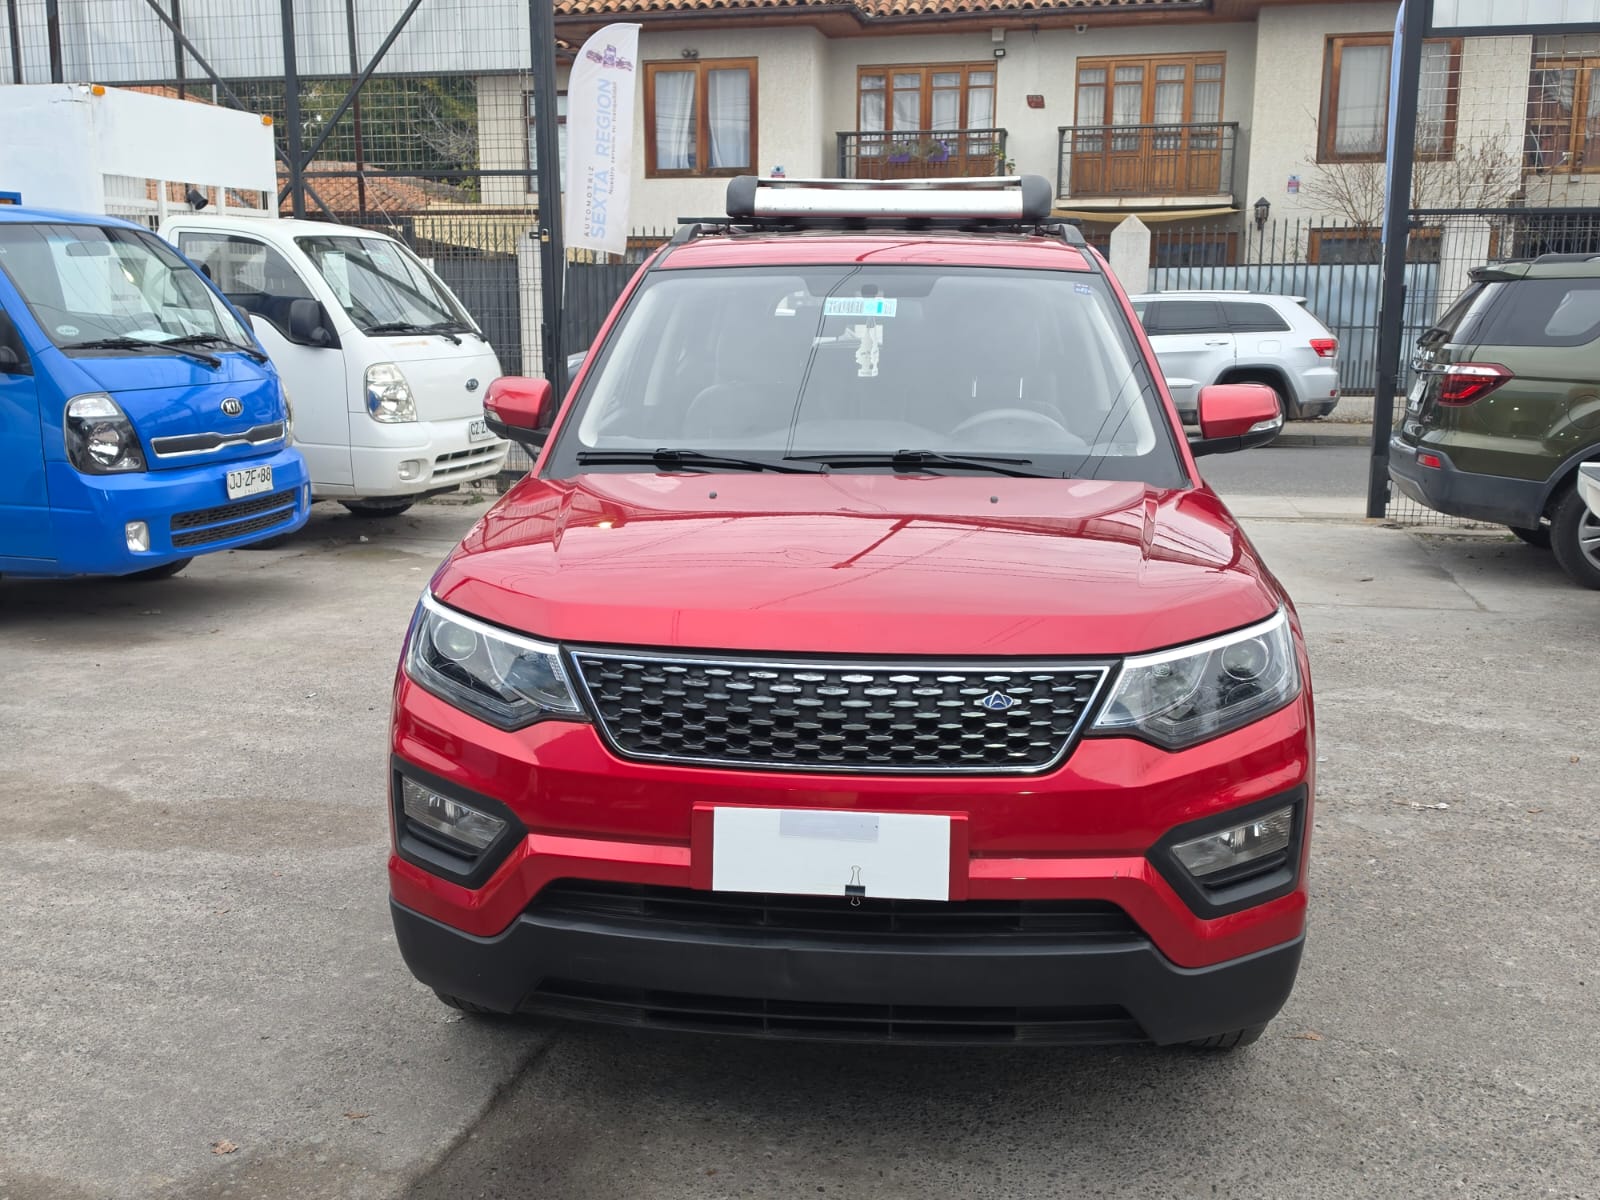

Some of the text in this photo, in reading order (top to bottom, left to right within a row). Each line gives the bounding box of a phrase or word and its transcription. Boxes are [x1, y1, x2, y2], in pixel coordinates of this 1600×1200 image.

[590, 78, 611, 239] SEXTA REGION
[584, 166, 593, 238] AUTOMOTRIZ
[225, 401, 240, 413] KIA
